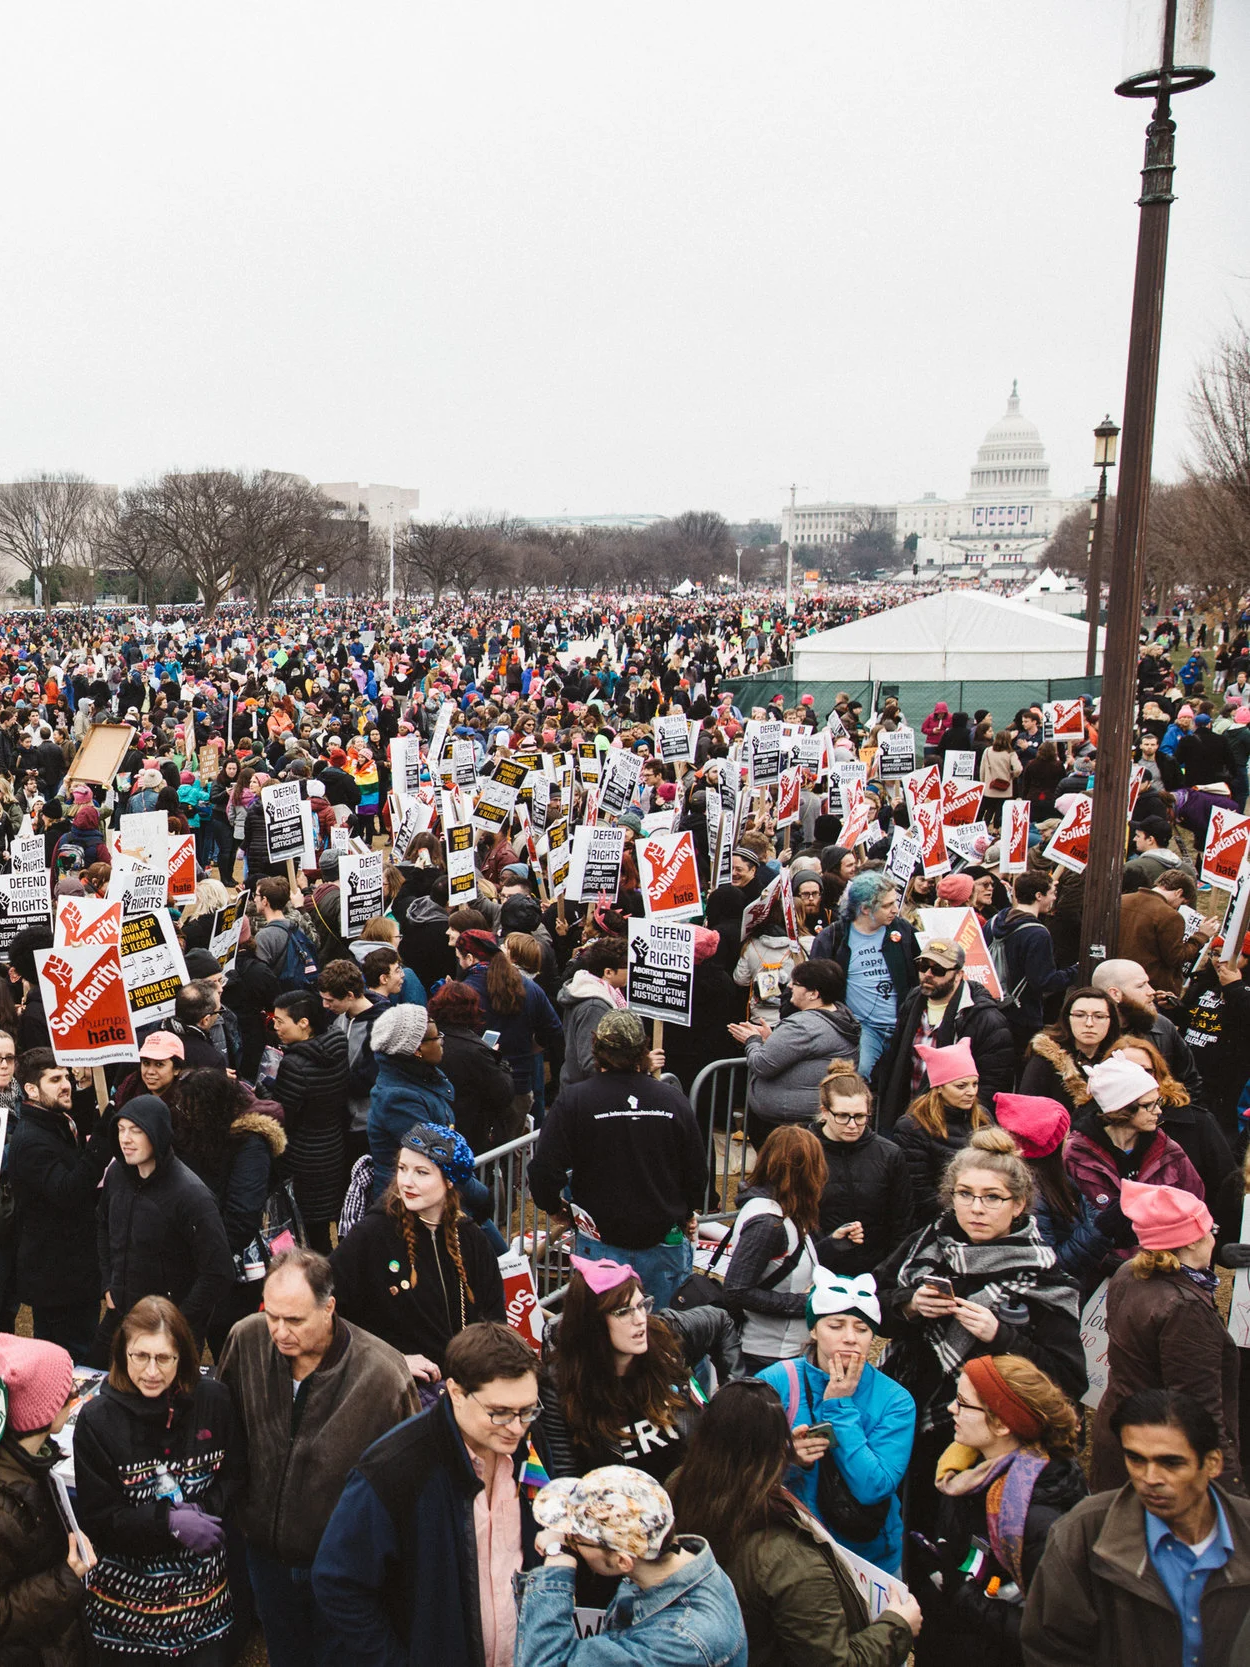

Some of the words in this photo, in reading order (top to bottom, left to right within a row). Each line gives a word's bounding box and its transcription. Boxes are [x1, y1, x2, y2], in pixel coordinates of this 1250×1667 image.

[666, 728, 687, 736] RIGHTS
[760, 724, 781, 734] DEFEND
[760, 740, 780, 750] RIGHTS
[801, 738, 821, 746] DEFEND
[800, 750, 820, 758] RIGHTS
[959, 753, 974, 761] DEFEND
[841, 764, 865, 772] DEFEND
[957, 766, 973, 774] RIGHTS
[273, 784, 298, 798] DEFEND
[276, 804, 300, 818] RIGHTS
[593, 829, 622, 840] DEFEND
[956, 824, 984, 835] DEFEND
[21, 838, 43, 852] DEFEND
[271, 839, 291, 849] JUSTICE
[592, 840, 621, 850] WOMEN'S
[1205, 826, 1248, 861] Solidarity
[359, 854, 381, 868] DEFEND
[591, 850, 620, 861] RIGHTS
[22, 858, 44, 873] RIGHTS
[648, 842, 693, 901] Solidarity
[1215, 863, 1236, 878] hate
[10, 876, 47, 889] DEFEND
[134, 874, 165, 887] DEFEND
[360, 875, 382, 890] RIGHTS
[10, 888, 47, 898] WOMEN'S
[133, 886, 163, 896] WOMEN'S
[172, 883, 192, 893] hate
[131, 896, 162, 909] RIGHTS
[673, 891, 694, 905] hate
[11, 899, 48, 913] RIGHTS
[27, 915, 47, 923] RIGHTS
[141, 918, 155, 930] SER
[121, 931, 151, 946] HUMANO
[650, 925, 691, 942] DEFEND
[121, 946, 129, 955] ES
[130, 937, 157, 952] ILEGAL!
[650, 939, 690, 955] WOMEN'S
[858, 946, 876, 956] end
[650, 951, 690, 970] RIGHTS
[861, 958, 883, 967] rape
[633, 966, 663, 978] ABORTION
[665, 971, 688, 982] RIGHTS
[652, 977, 666, 986] AND
[134, 983, 159, 998] HUMAN
[632, 981, 687, 999] REPRODUCTIVE
[50, 958, 123, 1037] Solidarity
[136, 998, 144, 1008] IS
[145, 989, 176, 1005] ILLEGAL!
[632, 992, 662, 1003] JUSTICE
[665, 996, 686, 1007] NOW!
[78, 1016, 127, 1030] Trumps
[87, 1026, 126, 1044] hate
